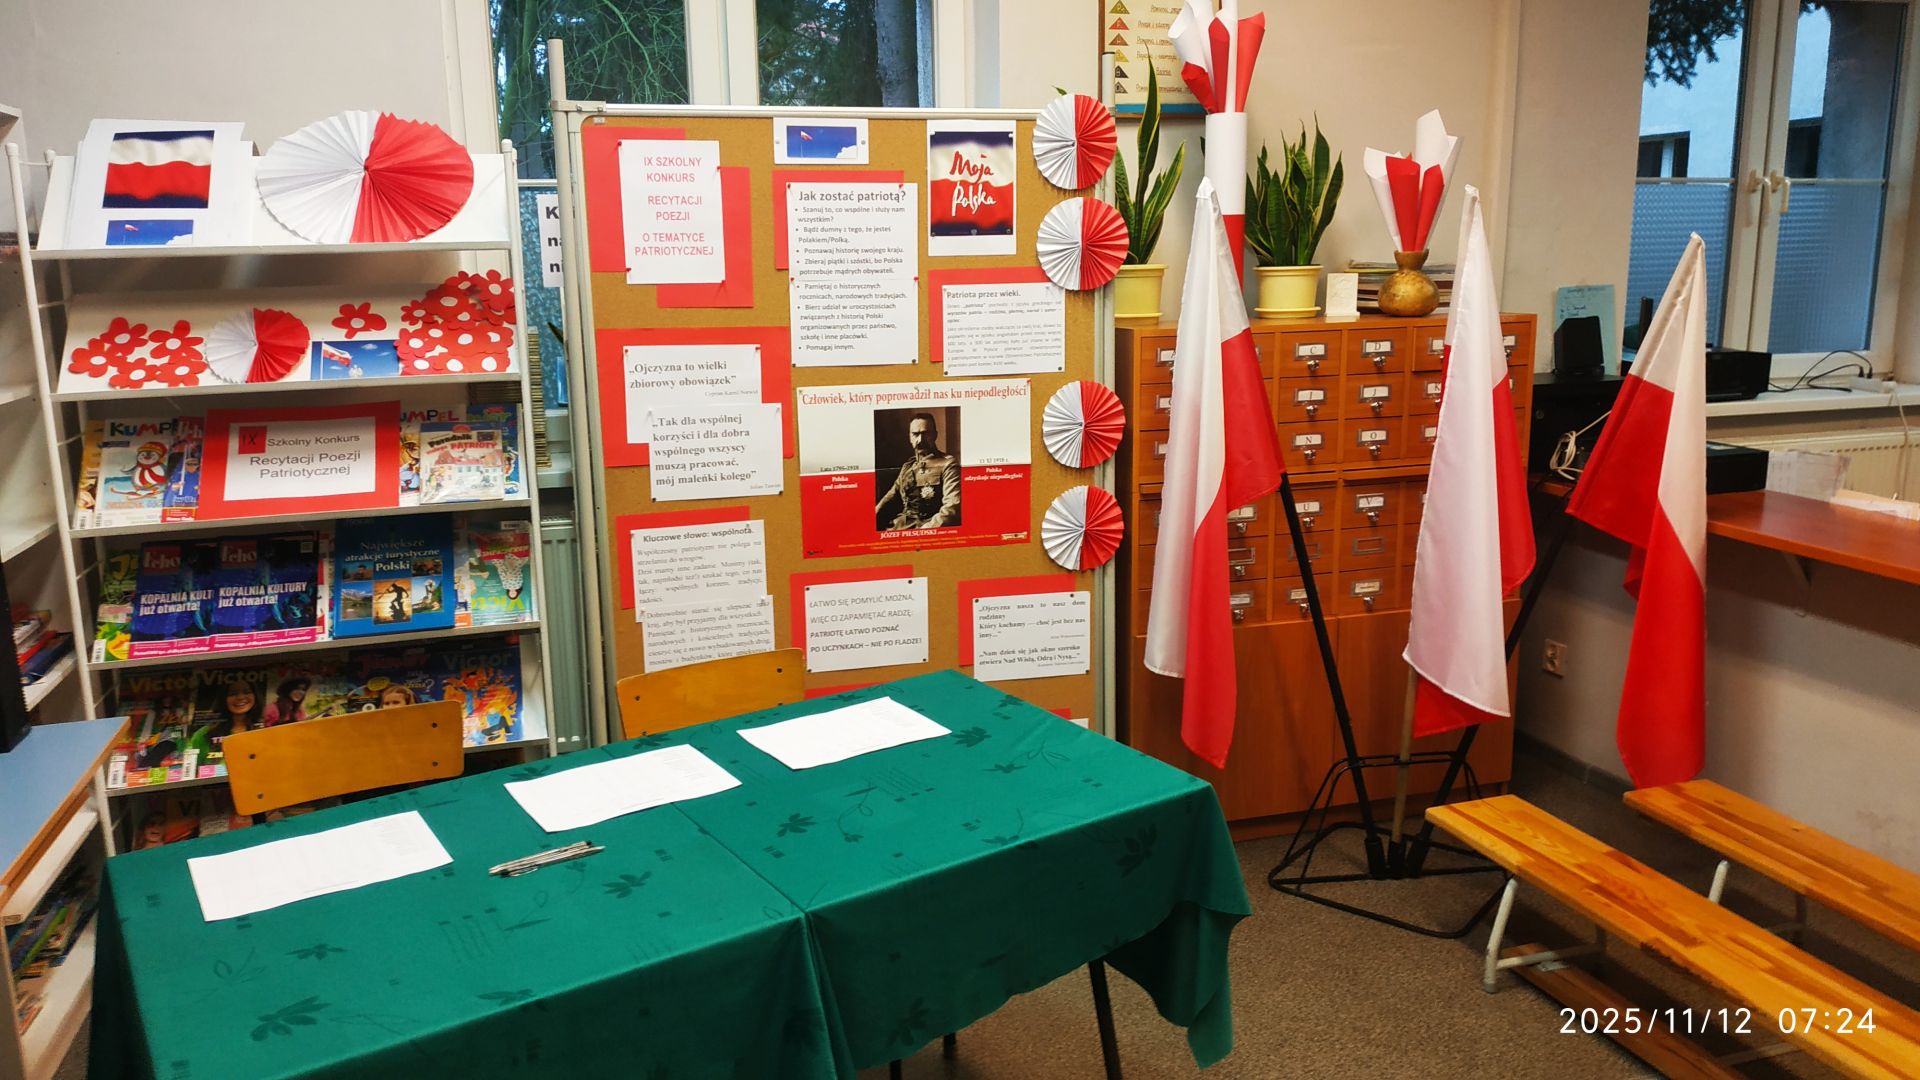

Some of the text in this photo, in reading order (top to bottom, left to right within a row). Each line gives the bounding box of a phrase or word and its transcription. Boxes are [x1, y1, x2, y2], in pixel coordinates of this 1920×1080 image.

[644, 157, 702, 167] IX SZKOLNY
[950, 150, 994, 183] Moja
[646, 172, 695, 183] KONKURS
[648, 195, 703, 206] RECYTACJI
[799, 190, 906, 204] Jak zostać patriotą?
[952, 181, 997, 216] Polska
[656, 211, 690, 221] POEZJI
[643, 232, 705, 243] O TEMATYCE
[634, 246, 714, 256] PATRIOTYCZNEJ
[1374, 342, 1381, 351] D
[242, 433, 360, 447] IX Szkolny Konkurs
[450, 441, 497, 449] PATRIOTY
[1305, 436, 1312, 444] N
[250, 450, 362, 467] Recytacji Poezji
[259, 464, 351, 479] Patriotycznej
[219, 582, 307, 597] KOPALNIA KULTURY
[140, 590, 212, 605] KOPALNIA KULT
[218, 594, 278, 608] już otwarta!
[139, 601, 200, 616] już otwarta!
